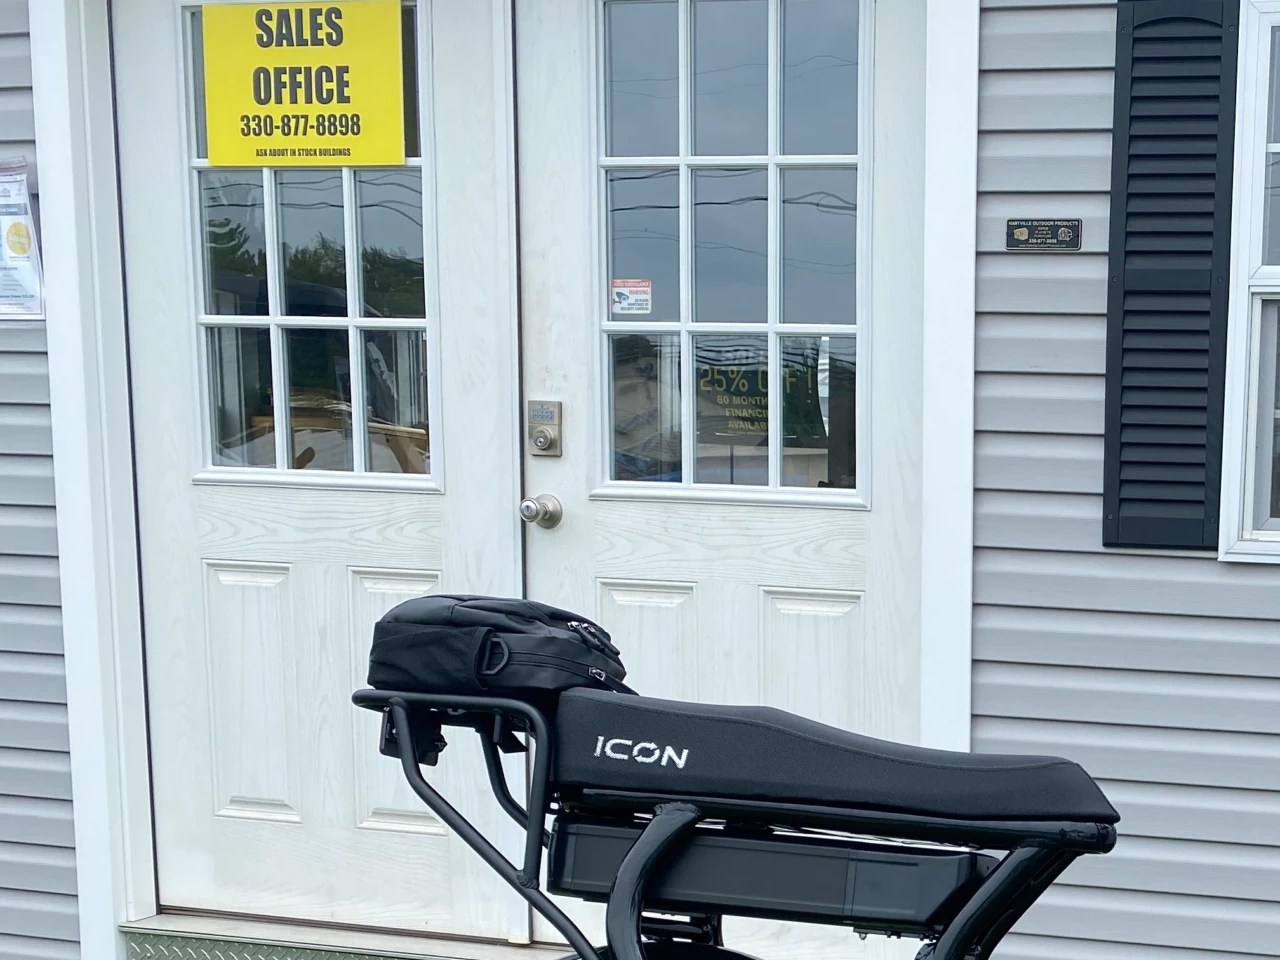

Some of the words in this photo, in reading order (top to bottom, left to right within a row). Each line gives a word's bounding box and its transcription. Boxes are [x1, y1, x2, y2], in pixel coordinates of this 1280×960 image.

[255, 7, 344, 48] SALES
[252, 65, 351, 105] OFFICE
[240, 113, 361, 137] 330-877-8898
[255, 148, 268, 157] ASK
[268, 148, 289, 157] ABOUT
[289, 148, 297, 157] IN
[297, 148, 318, 157] STOCK
[318, 147, 351, 157] BUILDINGS
[700, 366, 749, 393] 25%
[594, 735, 690, 769] ICON
